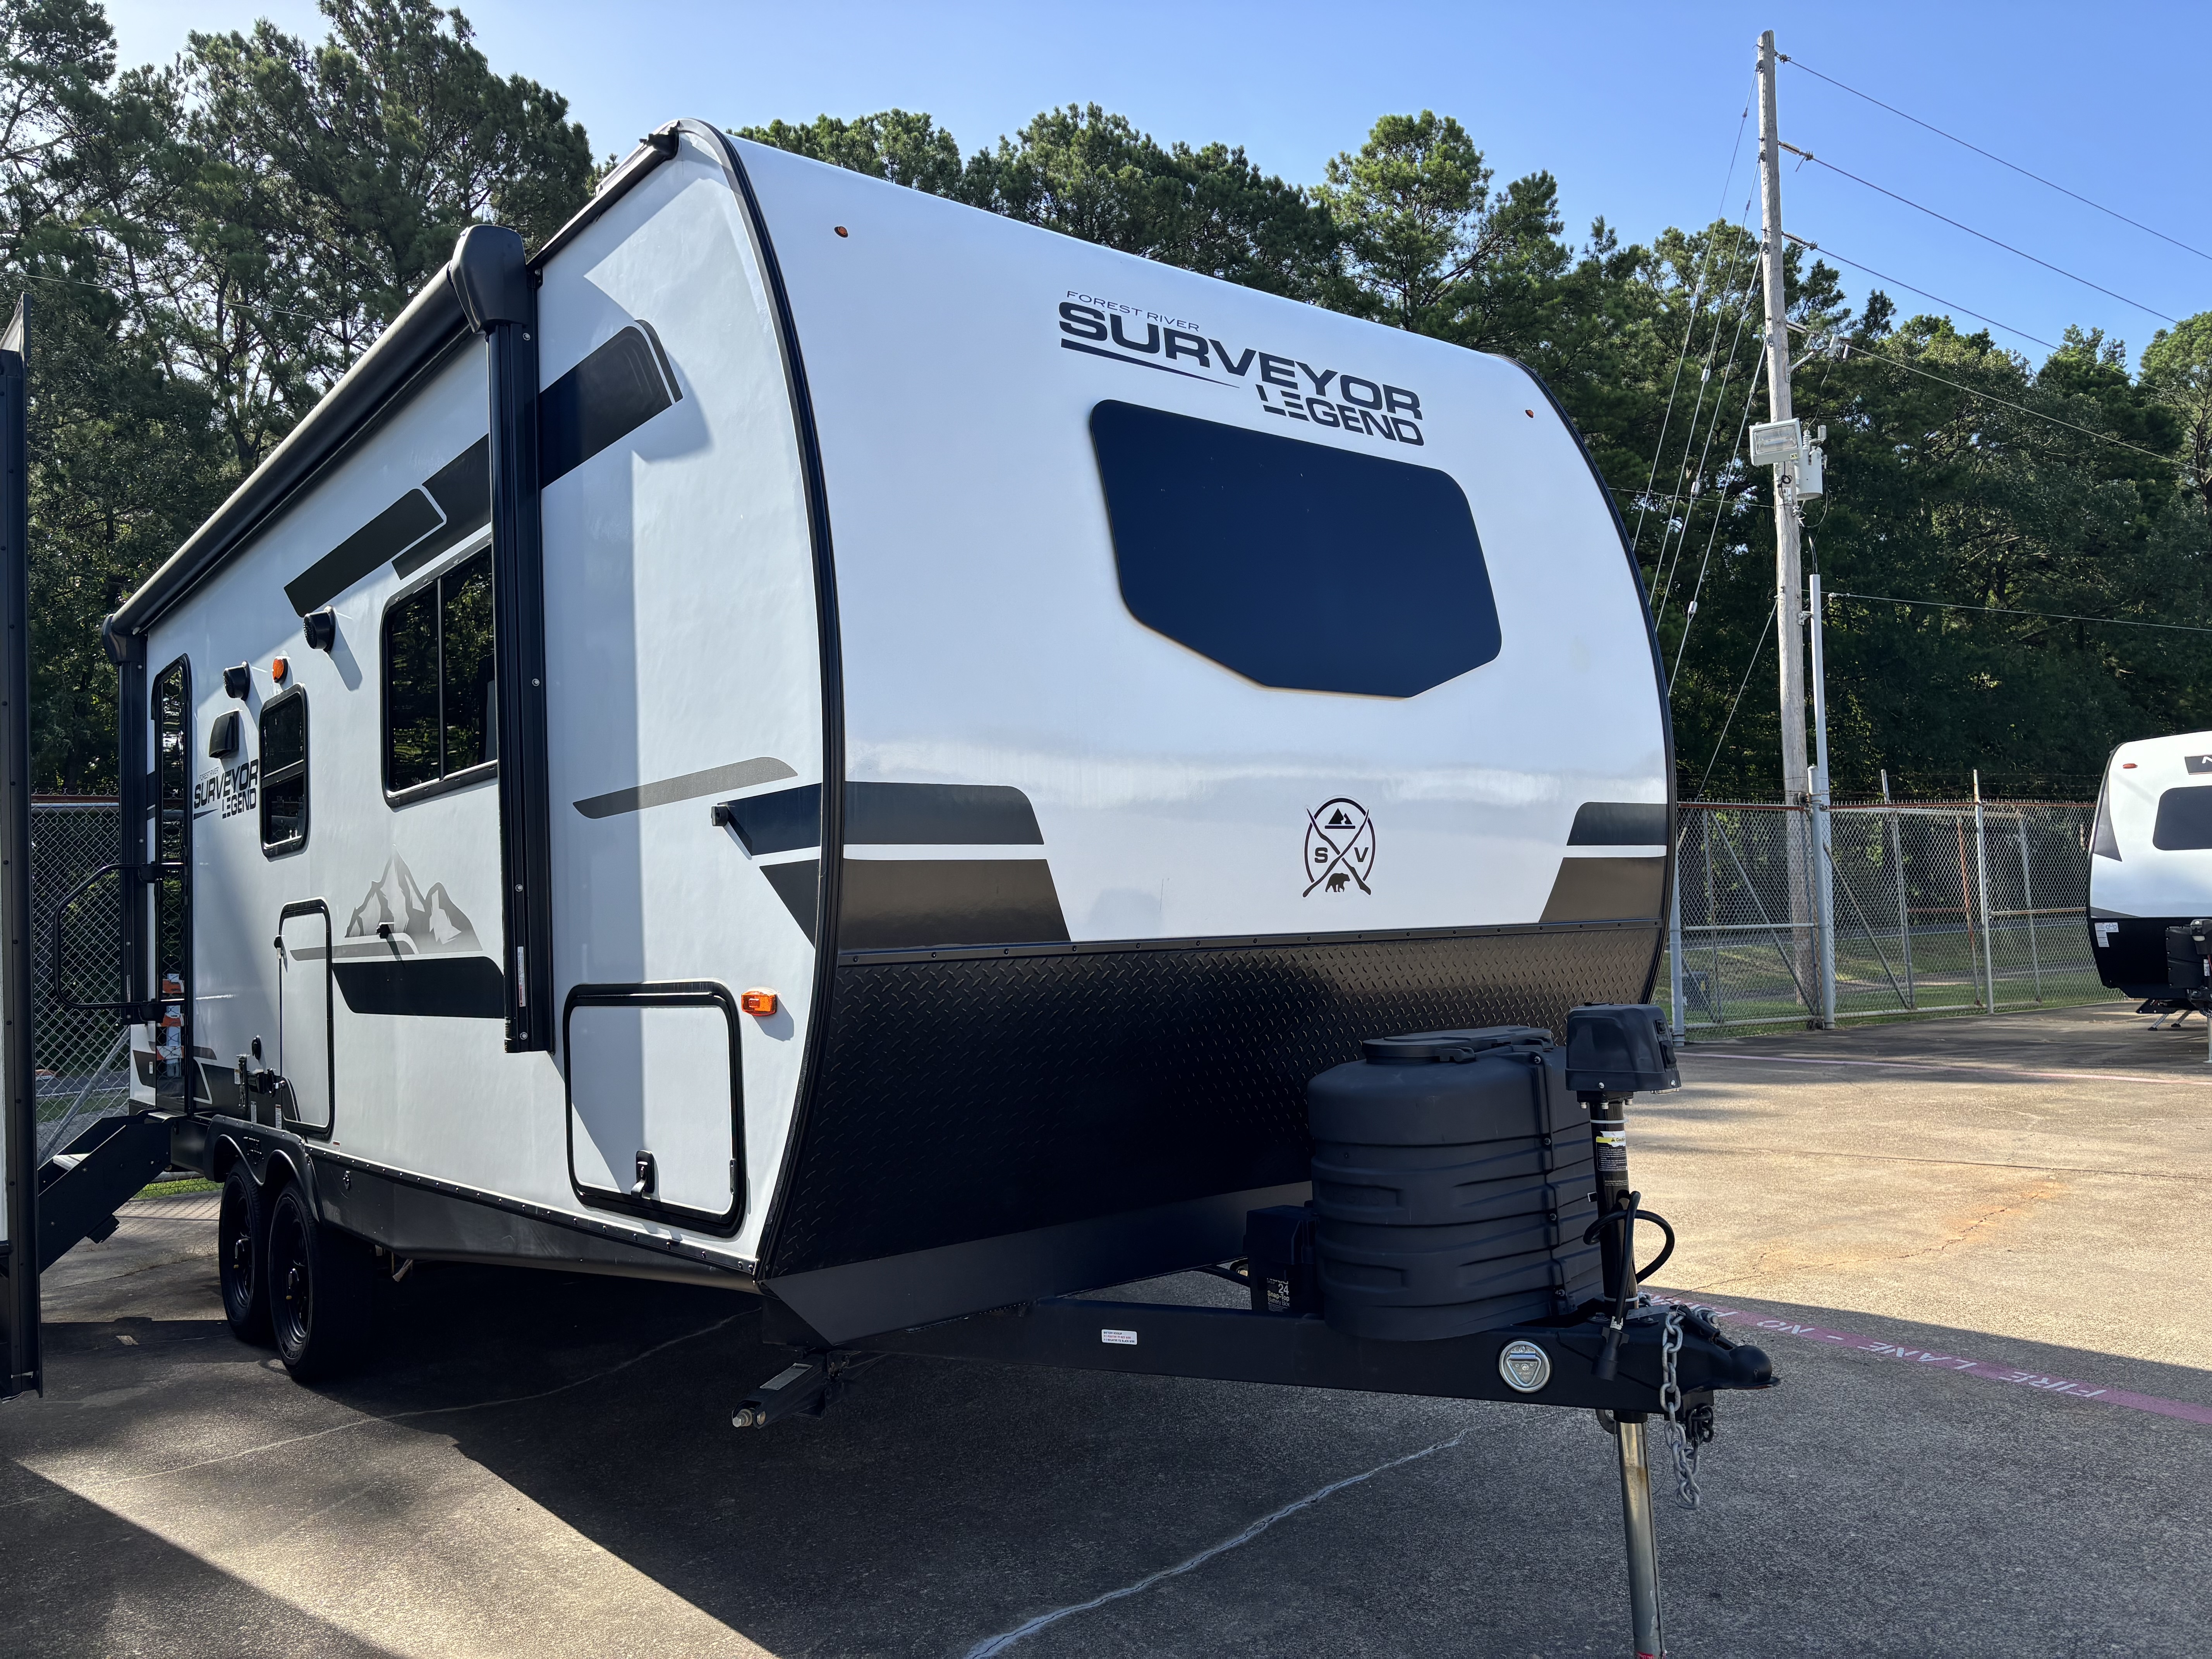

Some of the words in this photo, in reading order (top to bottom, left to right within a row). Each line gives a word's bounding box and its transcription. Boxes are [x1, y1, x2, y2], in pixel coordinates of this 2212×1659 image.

[1066, 291, 1142, 317] FOREST
[1146, 312, 1200, 332] RIVER
[1059, 302, 1423, 420] SURVEYOR
[1255, 384, 1424, 446] LEGEND
[194, 759, 259, 809] SURVEYOR
[222, 788, 256, 819] LEGEND
[1315, 847, 1328, 863] S
[1354, 847, 1369, 862] V
[1267, 1290, 1290, 1302] Snap-Top
[1278, 1283, 1289, 1295] 24
[1756, 1320, 1815, 1334] NO
[1857, 1341, 1977, 1370] LANE
[1998, 1371, 2107, 1398] FIRE
